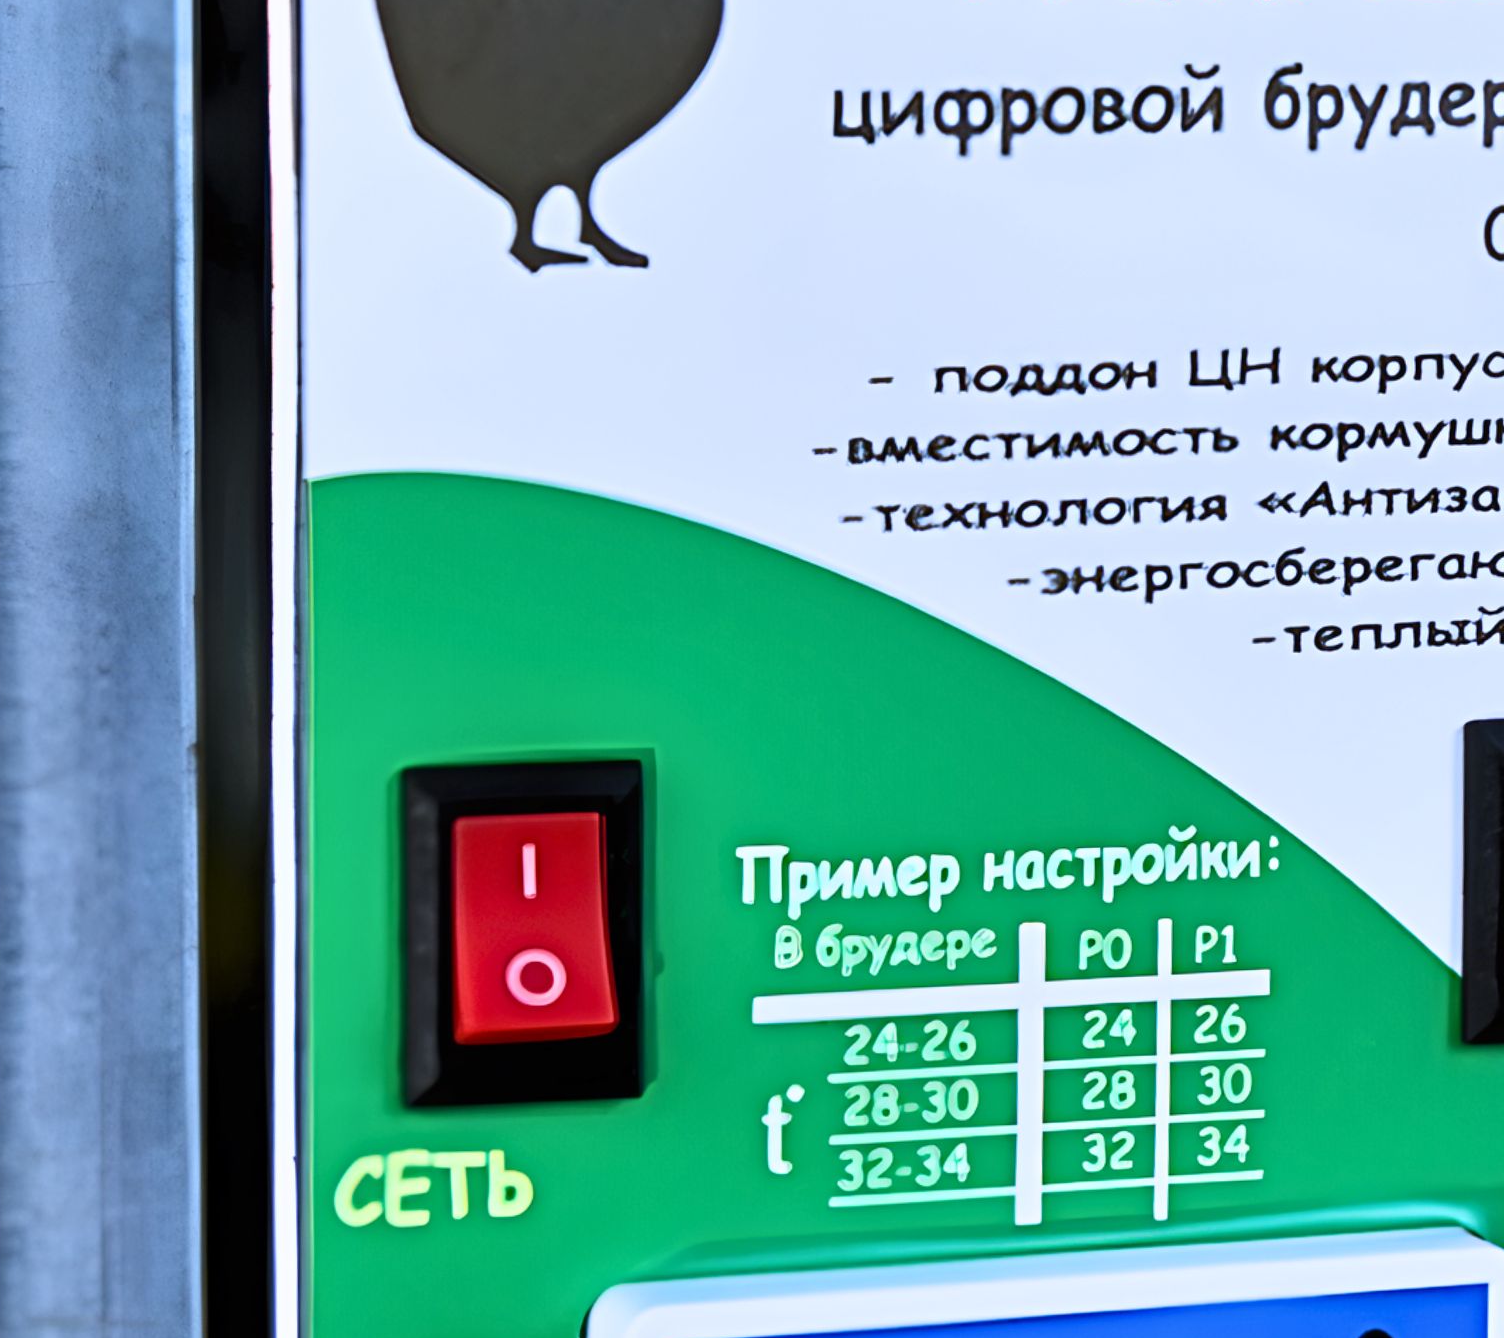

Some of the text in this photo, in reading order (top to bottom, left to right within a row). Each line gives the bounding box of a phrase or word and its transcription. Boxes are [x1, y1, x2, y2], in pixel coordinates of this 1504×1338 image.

[832, 66, 1224, 156] цифровой
[934, 360, 1158, 396] поддон
[1189, 347, 1281, 389] ЦН
[844, 493, 1227, 532] -технология
[736, 825, 1279, 919] Пример настройки:
[774, 924, 996, 977] В брудере
[843, 1020, 976, 1066] 24-26
[1082, 1008, 1136, 1049] 24
[1195, 1004, 1247, 1043] 26
[844, 1080, 978, 1126] 28-30
[1082, 1070, 1136, 1111] 28
[1197, 1063, 1252, 1106] 30
[837, 1143, 970, 1191] 32-34
[1082, 1131, 1136, 1172] 32
[1197, 1125, 1249, 1167] 34
[334, 1148, 533, 1228] СЕТЬ
